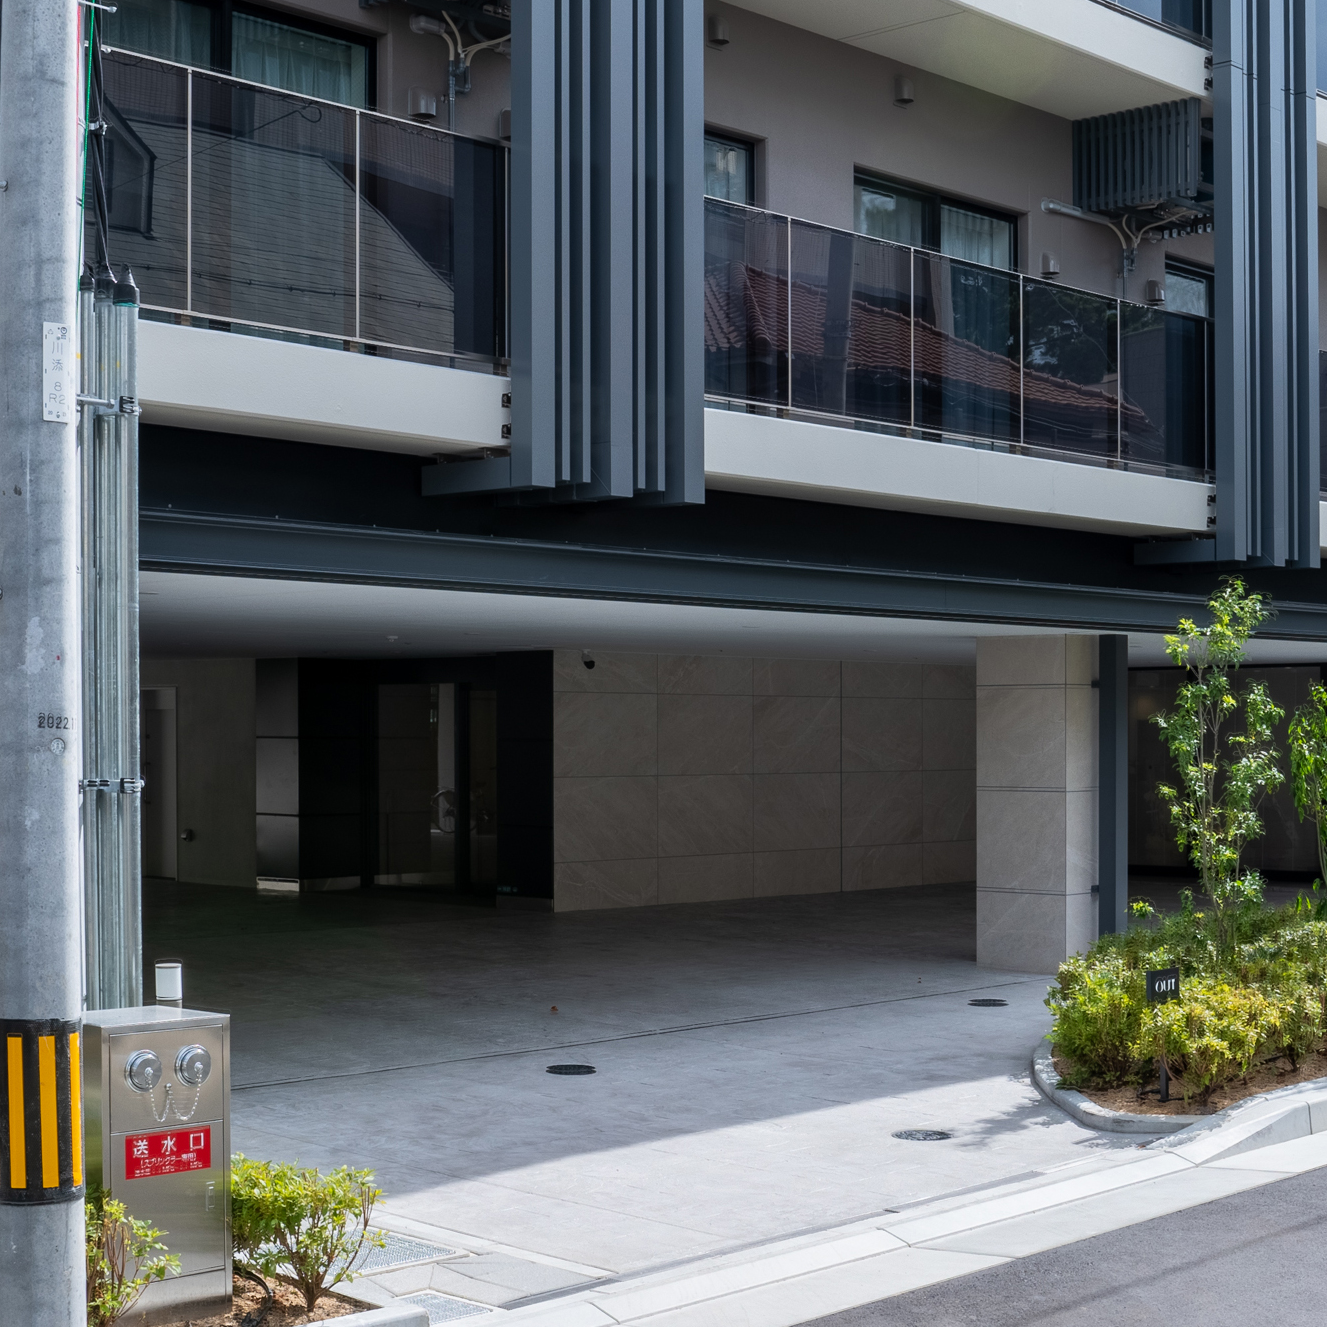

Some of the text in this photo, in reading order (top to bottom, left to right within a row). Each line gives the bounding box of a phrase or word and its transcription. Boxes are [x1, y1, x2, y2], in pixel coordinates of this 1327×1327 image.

[54, 381, 62, 392] 8
[49, 393, 66, 405] R2
[1155, 978, 1175, 992] OUT
[133, 1132, 204, 1158] 送水口
